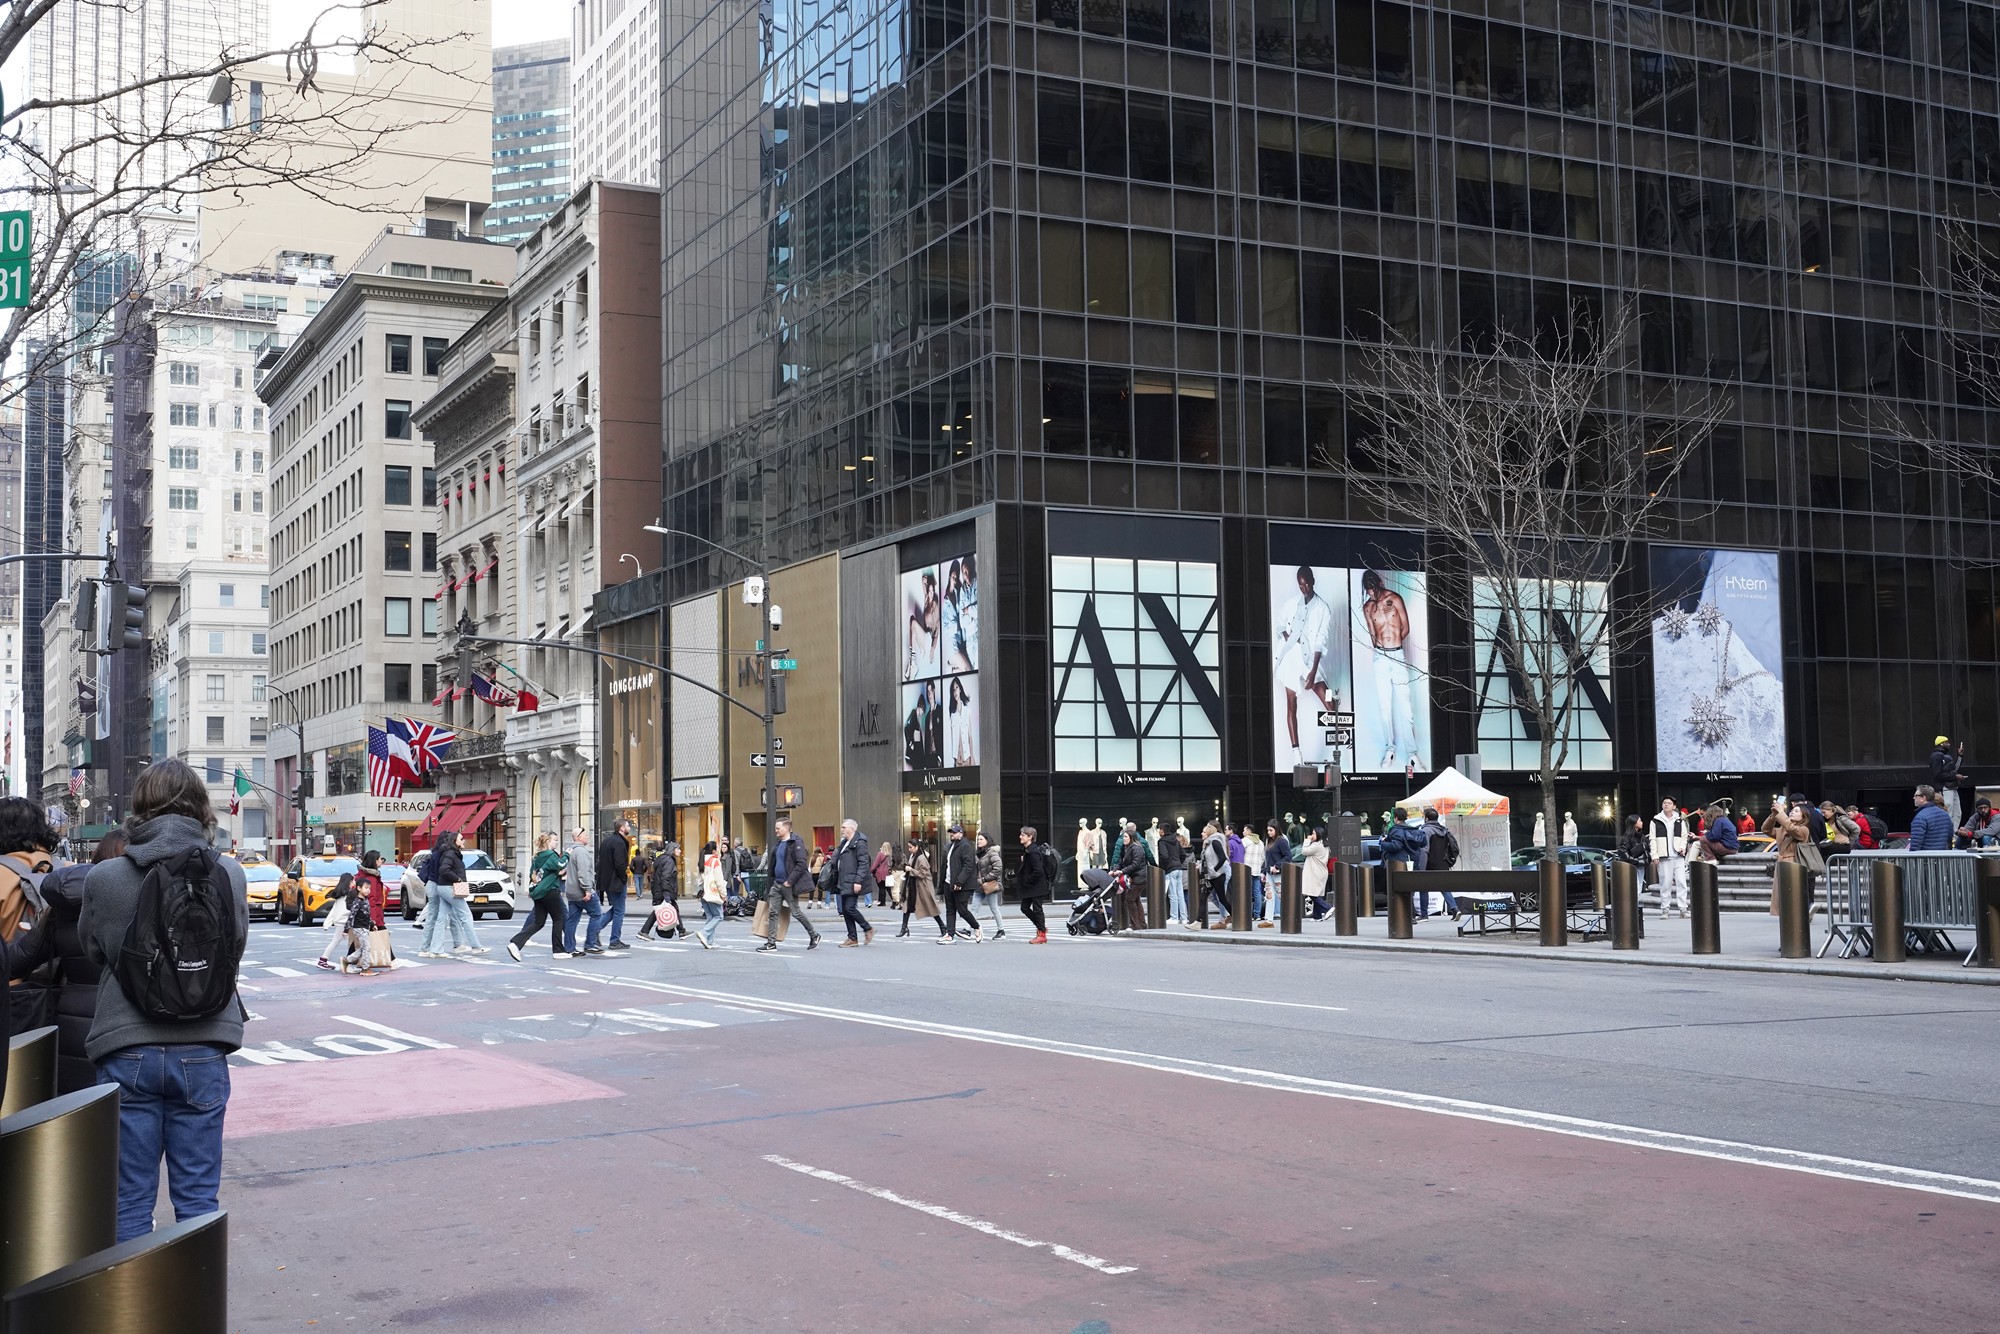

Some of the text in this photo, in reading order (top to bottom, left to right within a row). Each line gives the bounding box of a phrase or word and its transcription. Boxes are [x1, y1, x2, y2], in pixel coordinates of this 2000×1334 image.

[784, 660, 790, 668] 51
[609, 672, 653, 696] LONGCHAMP
[378, 801, 433, 811] FERRAGA
